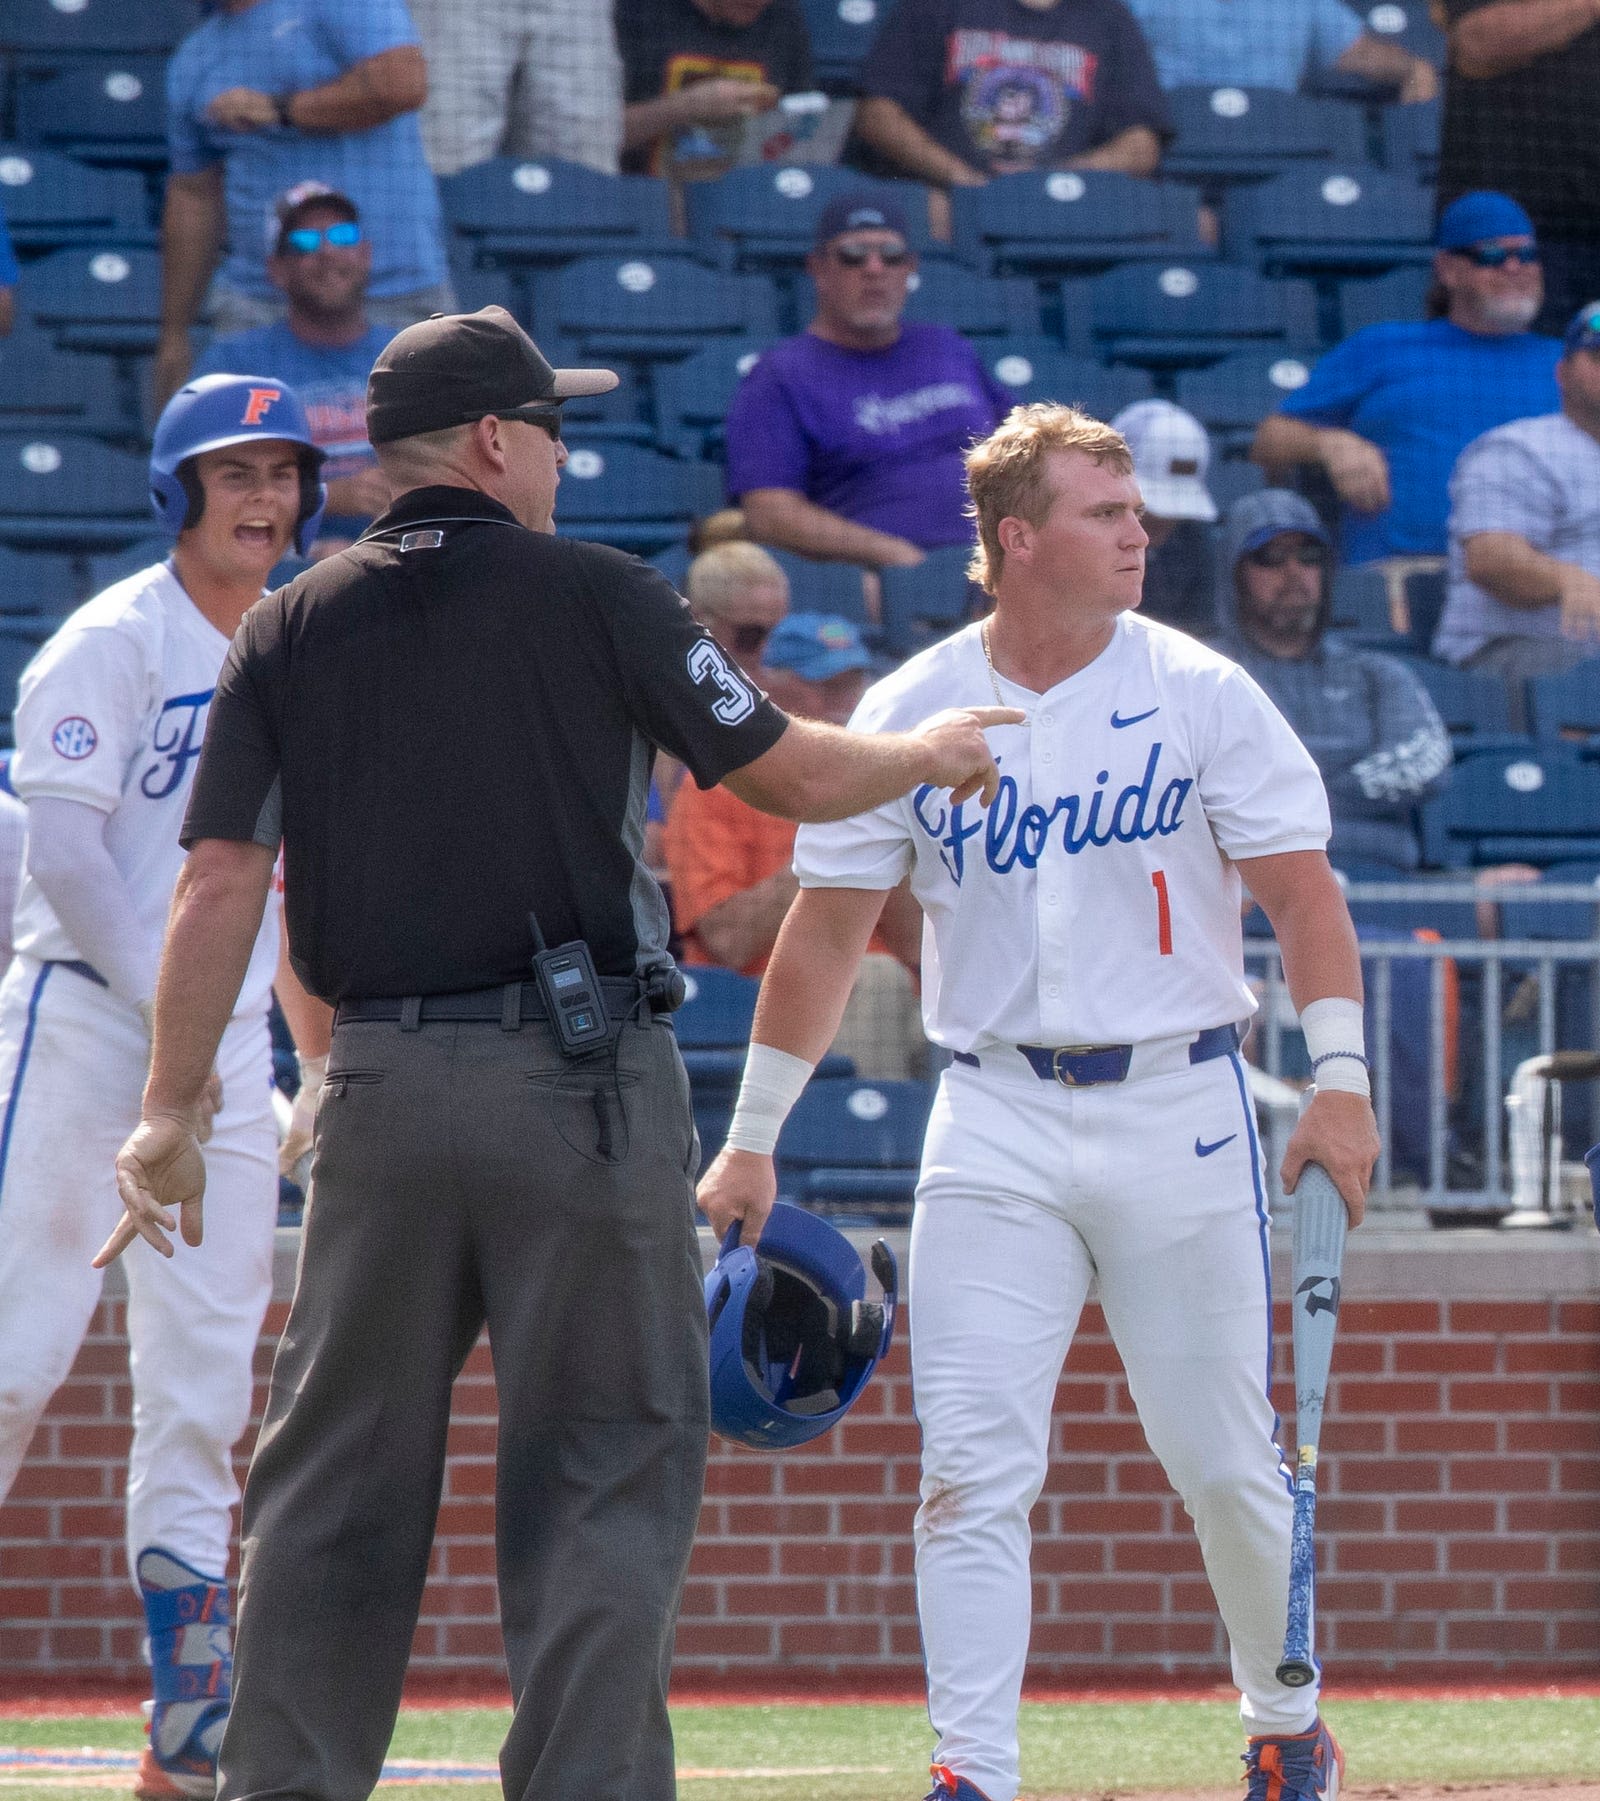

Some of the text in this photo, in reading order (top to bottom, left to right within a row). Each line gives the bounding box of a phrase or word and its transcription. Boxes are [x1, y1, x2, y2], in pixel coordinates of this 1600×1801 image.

[240, 388, 281, 426] F
[54, 720, 97, 757] SEC
[913, 742, 1194, 888] Florida
[1151, 869, 1173, 956] 1
